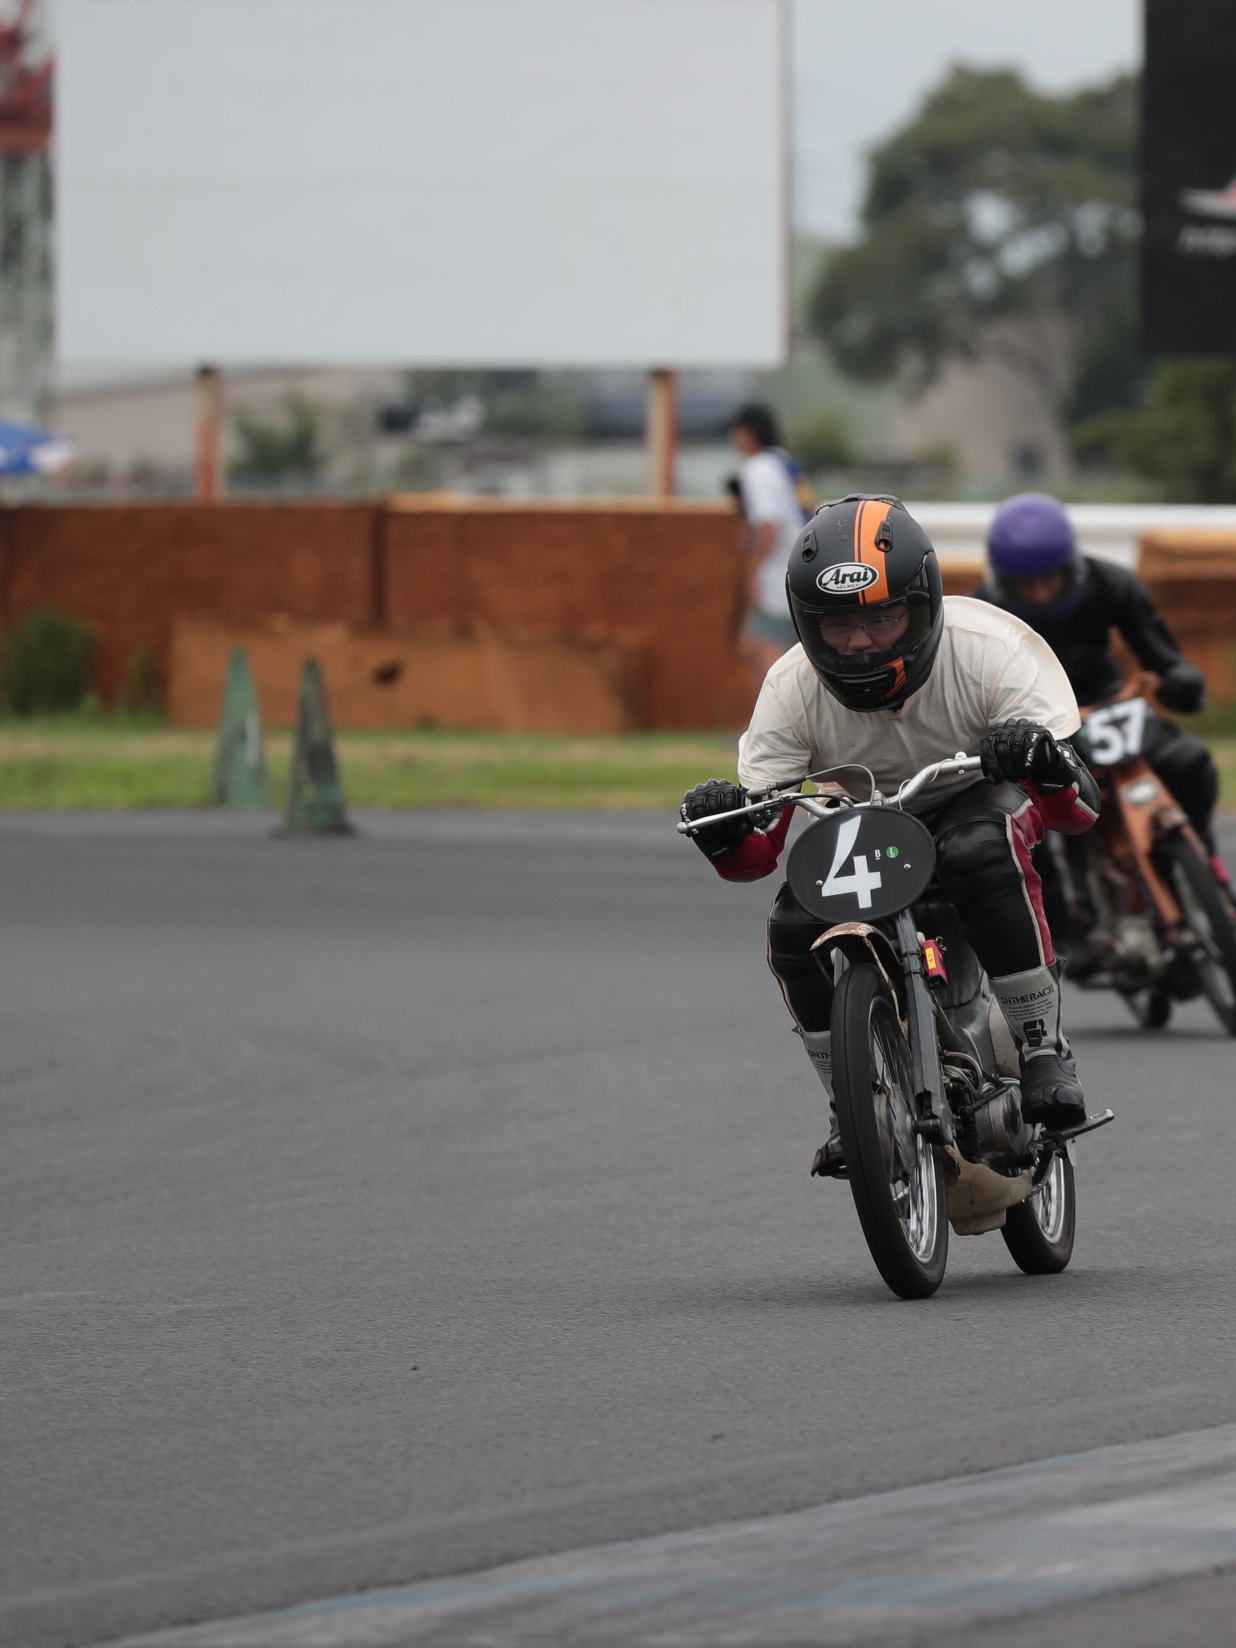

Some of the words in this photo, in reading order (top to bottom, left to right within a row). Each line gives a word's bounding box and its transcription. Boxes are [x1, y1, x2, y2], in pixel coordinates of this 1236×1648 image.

[821, 567, 870, 587] Arai
[1086, 697, 1146, 765] 57
[821, 815, 882, 909] 4
